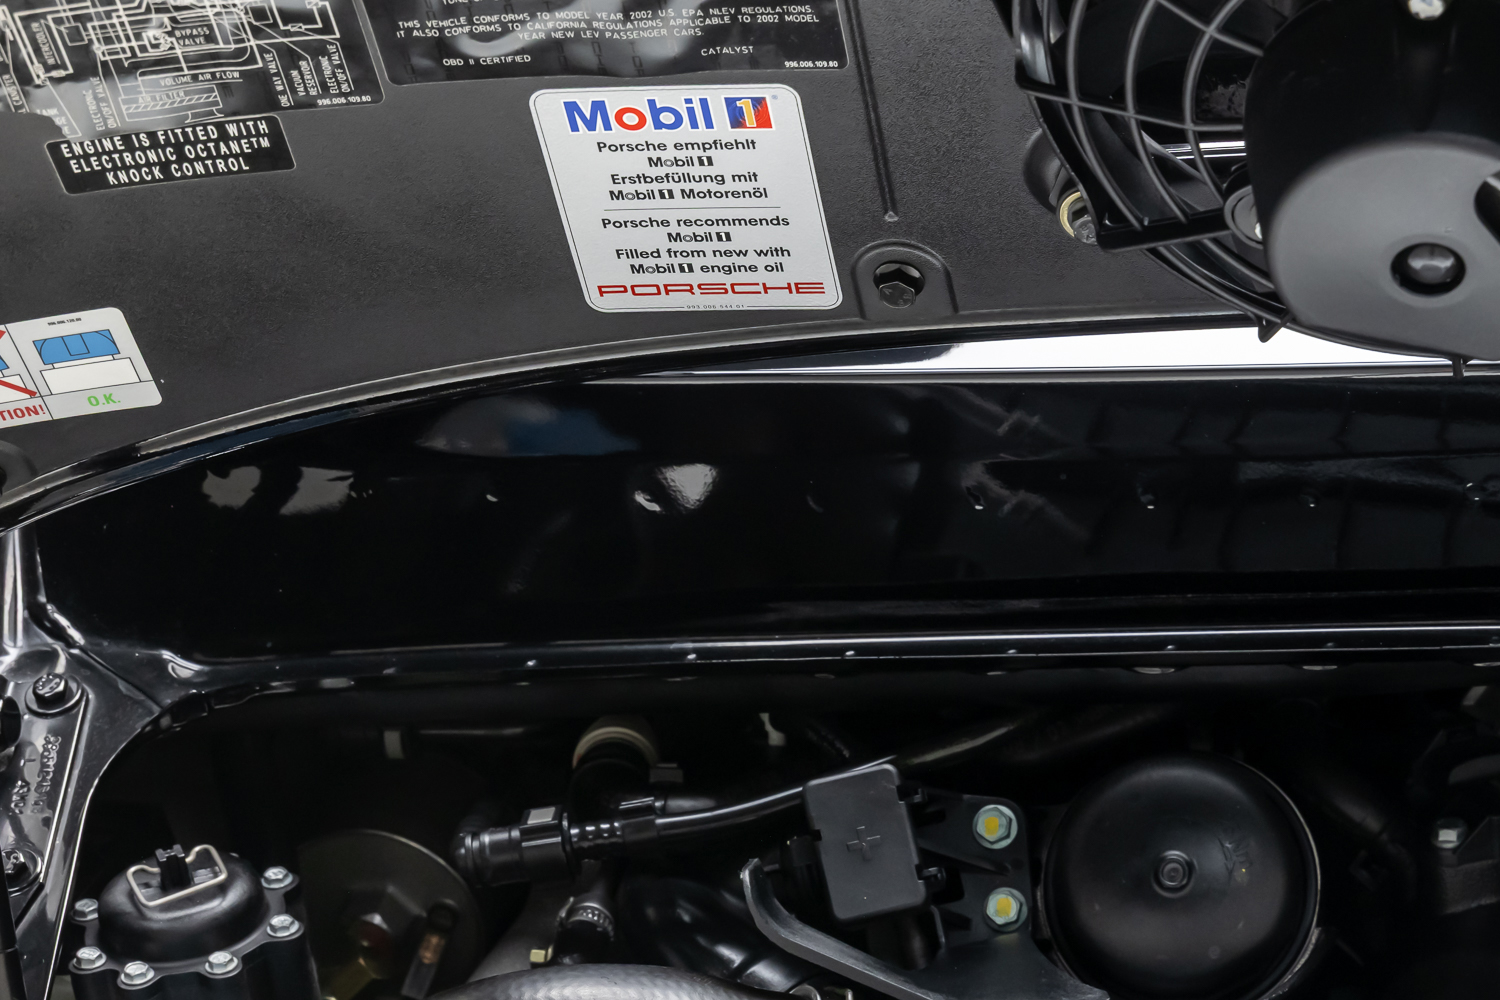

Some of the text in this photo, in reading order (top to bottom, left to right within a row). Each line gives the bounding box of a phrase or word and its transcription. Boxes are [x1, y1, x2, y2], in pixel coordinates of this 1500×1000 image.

[398, 20, 420, 29] THIS
[426, 17, 467, 28] VEHICLE
[473, 13, 530, 24] CONFORMS
[537, 12, 550, 20] TO
[555, 11, 590, 20] MODEL
[596, 12, 624, 20] YEAR
[630, 10, 652, 20] 2002
[682, 8, 704, 17] EPA
[741, 5, 815, 14] REGULATIONS.
[174, 27, 210, 38] BYPASS
[412, 29, 439, 37] ALSO
[444, 24, 502, 37] CONFORMS
[508, 23, 521, 31] TO
[527, 20, 587, 31] CALIFORNIA
[592, 19, 663, 30] REGULATIONS
[669, 15, 731, 27] APPLICABLE
[737, 15, 751, 23] TO
[757, 14, 779, 23] 2002
[785, 14, 820, 23] MODEL
[518, 28, 704, 40] YEAR NEW LEV PASSENGER CARS.
[178, 37, 206, 46] VALVE
[701, 46, 753, 56] CATALYST
[443, 58, 464, 66] OBD
[480, 55, 531, 65] CERTIFIED
[319, 55, 339, 94] ELECTRONIC
[327, 44, 351, 93] ON/OFF VALVE
[160, 71, 240, 86] VOLUME AIR FLOW
[263, 52, 290, 107] ONE WAY VALVE
[299, 60, 318, 96] RESERVOIR
[90, 76, 117, 129] ON/OFF VALVE
[83, 90, 105, 131] ELECTRONIC
[562, 97, 715, 132] Mobil
[60, 120, 269, 157] ENGINE IS FITTED WITH
[597, 139, 756, 153] Porsche empfiehlt
[70, 147, 177, 174] ELECTRONIC
[647, 156, 695, 167] Mobil
[106, 157, 249, 185] KNOCK CONTROL
[610, 172, 758, 185] Erstbefüllung mit
[609, 189, 656, 201] Mobil
[680, 188, 768, 199] Motorenöl
[601, 215, 790, 229] Porsche recommends
[667, 232, 713, 243] Mobil
[615, 246, 791, 260] Filled from new with
[630, 263, 676, 274] Mobil
[700, 262, 759, 275] engine
[764, 262, 784, 273] oil
[597, 282, 826, 297] PORSCHE
[87, 393, 121, 407] O.K.
